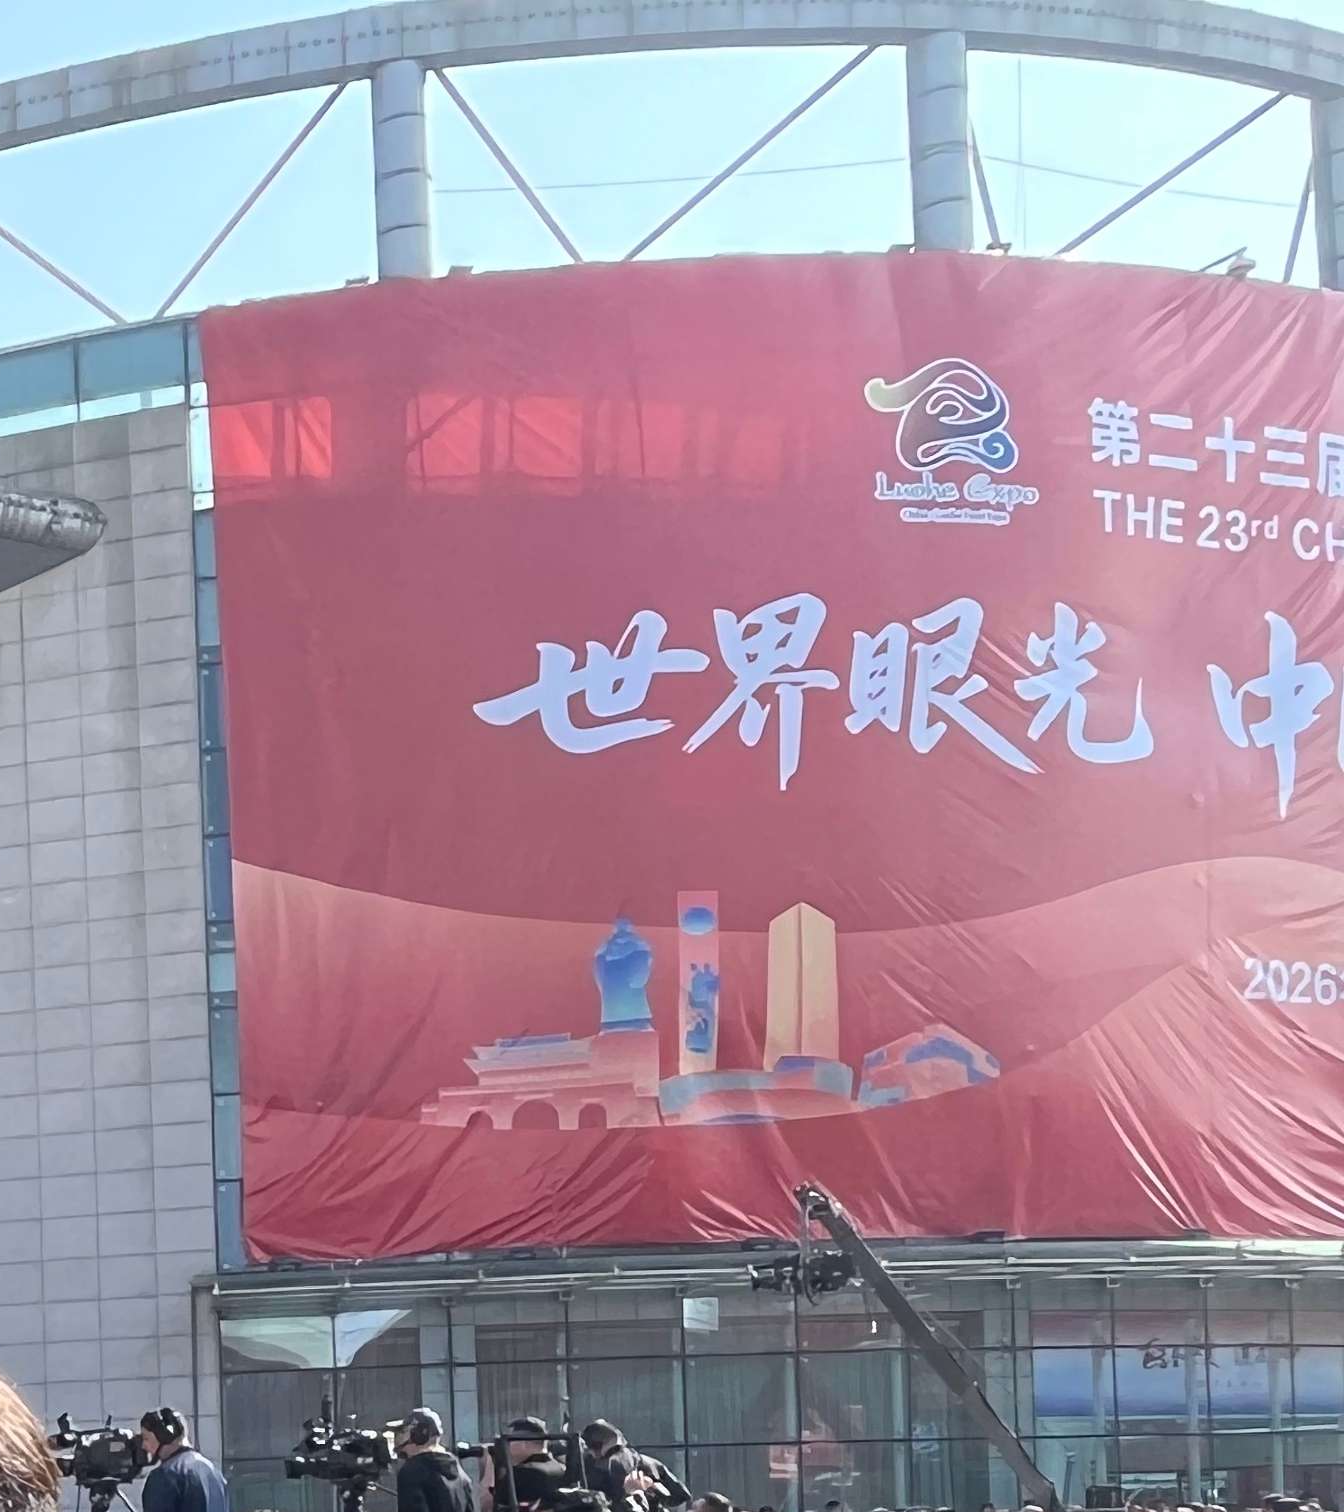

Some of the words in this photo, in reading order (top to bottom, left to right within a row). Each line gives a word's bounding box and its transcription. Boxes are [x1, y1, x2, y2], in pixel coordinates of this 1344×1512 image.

[875, 471, 960, 502] Luohe
[962, 473, 1040, 511] Expo
[1093, 489, 1185, 544] THE
[1196, 505, 1279, 552] 23rd
[472, 592, 1154, 790] 世界眼光
[1206, 610, 1344, 821] 中
[1243, 957, 1344, 1006] 2026
